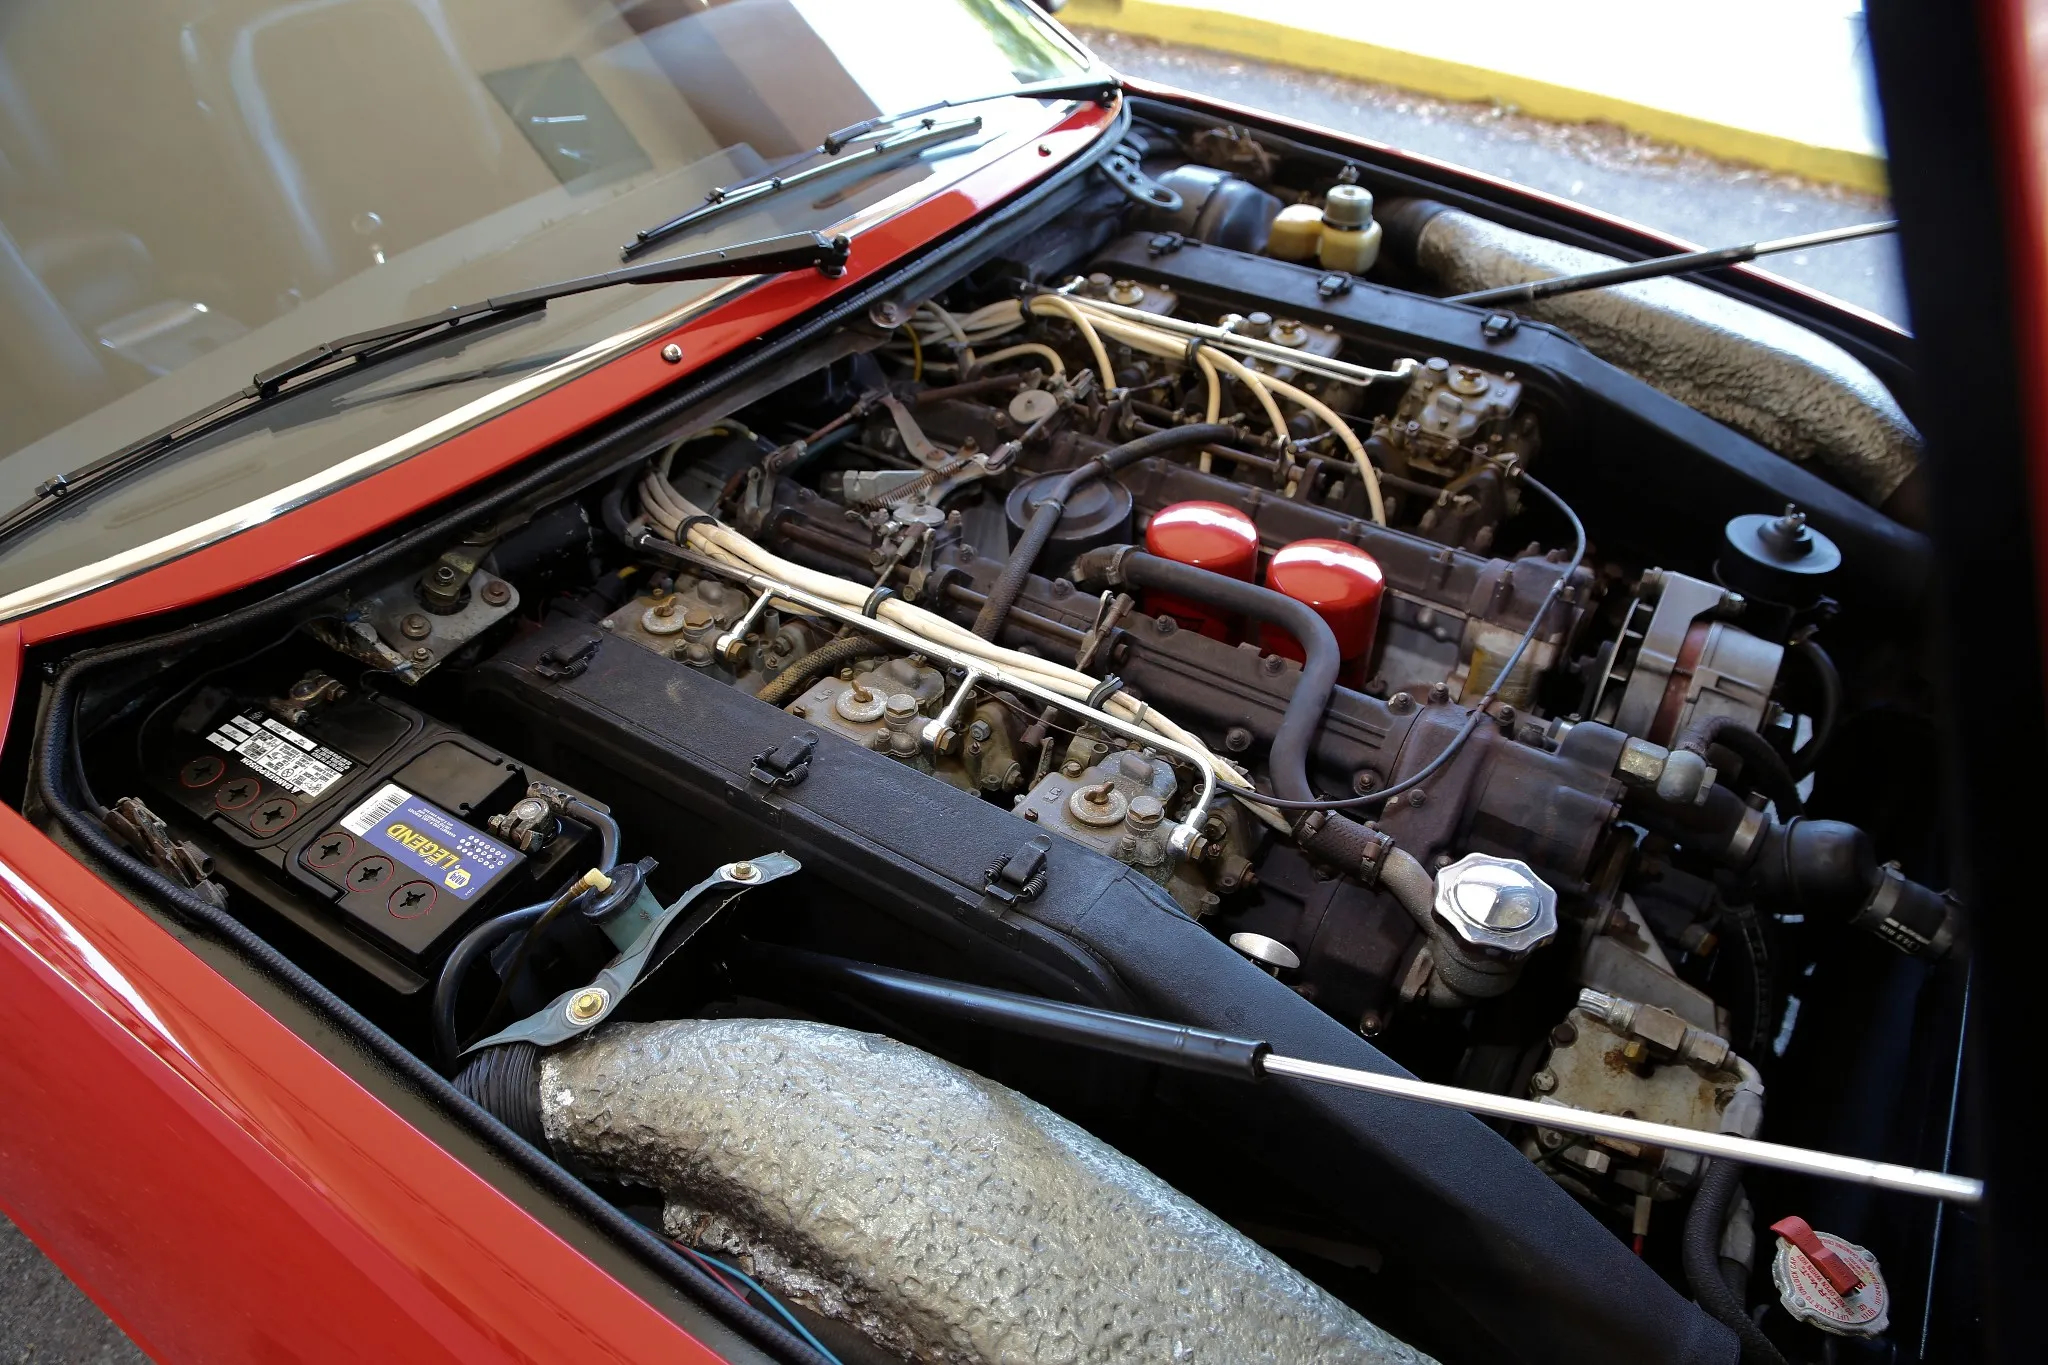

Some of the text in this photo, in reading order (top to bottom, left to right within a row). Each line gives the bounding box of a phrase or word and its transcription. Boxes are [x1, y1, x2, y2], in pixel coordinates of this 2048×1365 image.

[382, 820, 460, 872] LEGEND
[447, 870, 467, 887] NAPA
[1795, 1252, 1809, 1266] HOT
[1805, 1263, 1823, 1282] WHEN
[1789, 1270, 1807, 1296] UNLOCK
[1820, 1279, 1836, 1297] OPEN
[1804, 1294, 1815, 1304] TO
[1832, 1294, 1847, 1309] NOT
[1813, 1301, 1836, 1316] LEVER
